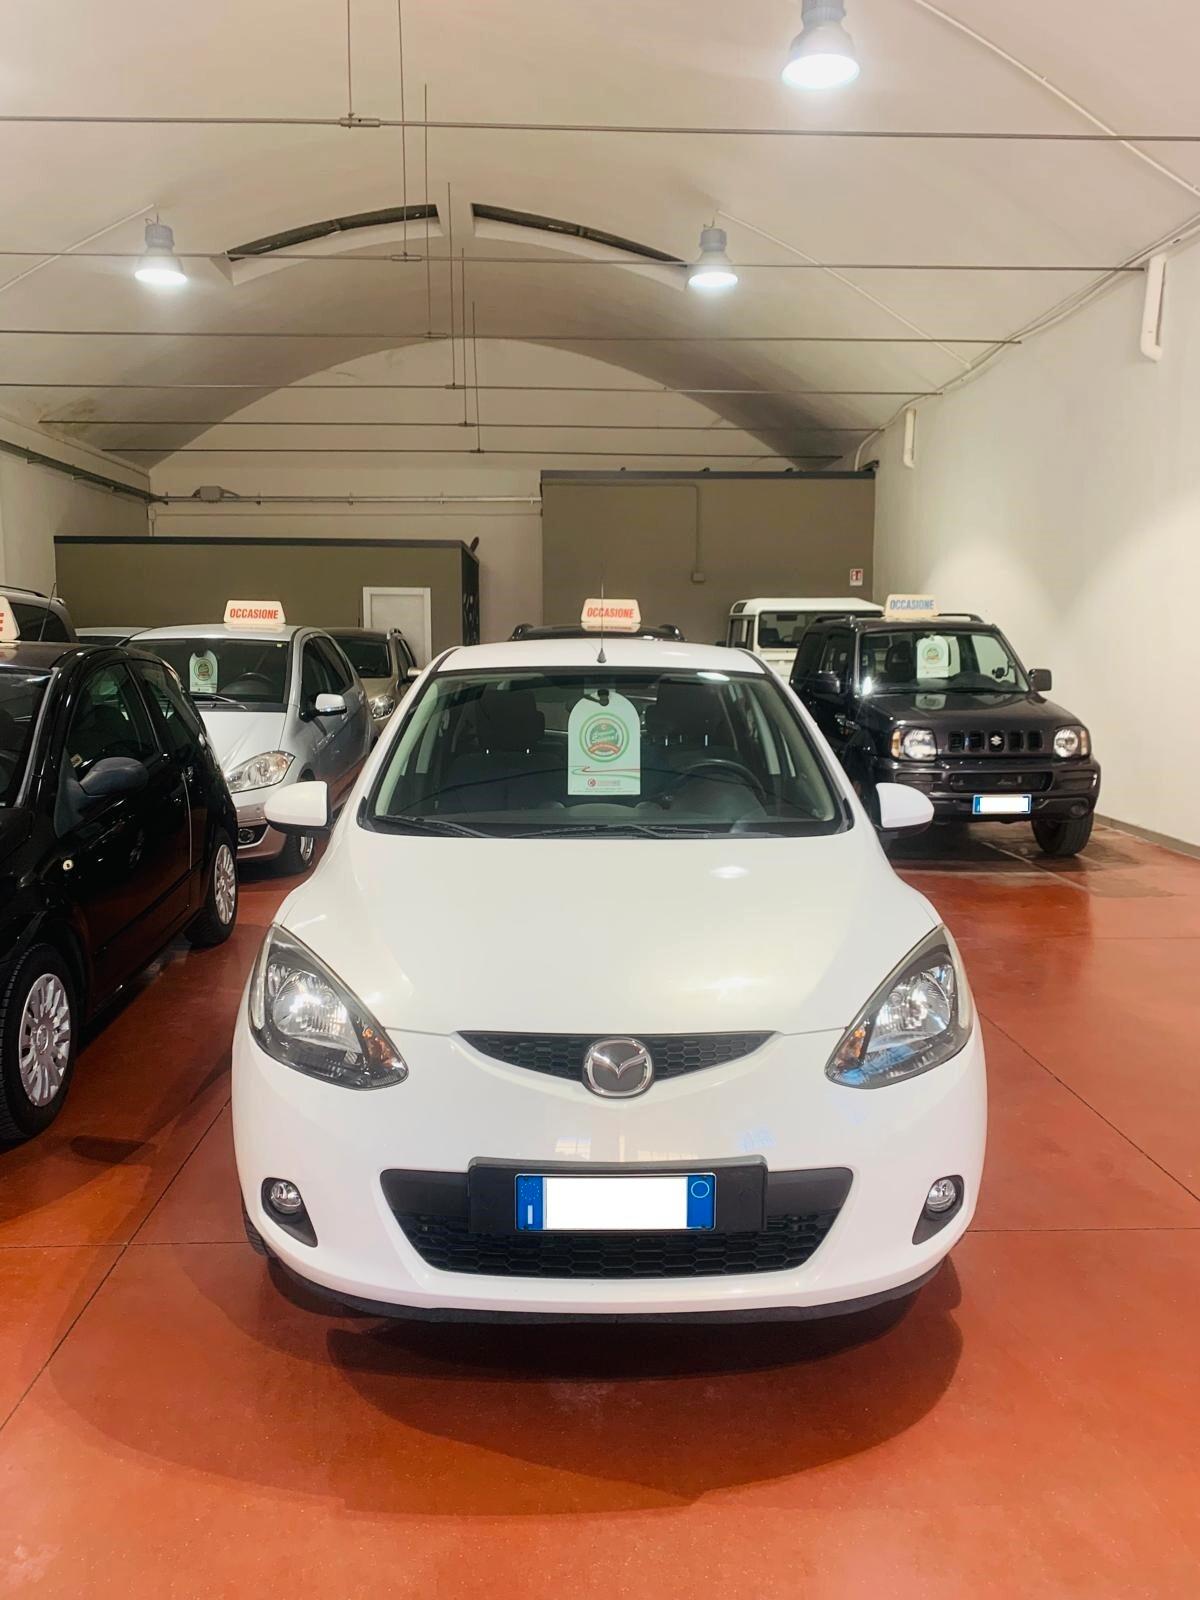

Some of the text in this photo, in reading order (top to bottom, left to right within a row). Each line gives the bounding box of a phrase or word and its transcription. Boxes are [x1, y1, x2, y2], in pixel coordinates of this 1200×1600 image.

[890, 599, 934, 610] OCCASIONE
[230, 608, 279, 619] OCCASIONE
[587, 607, 634, 618] OCCASIONE
